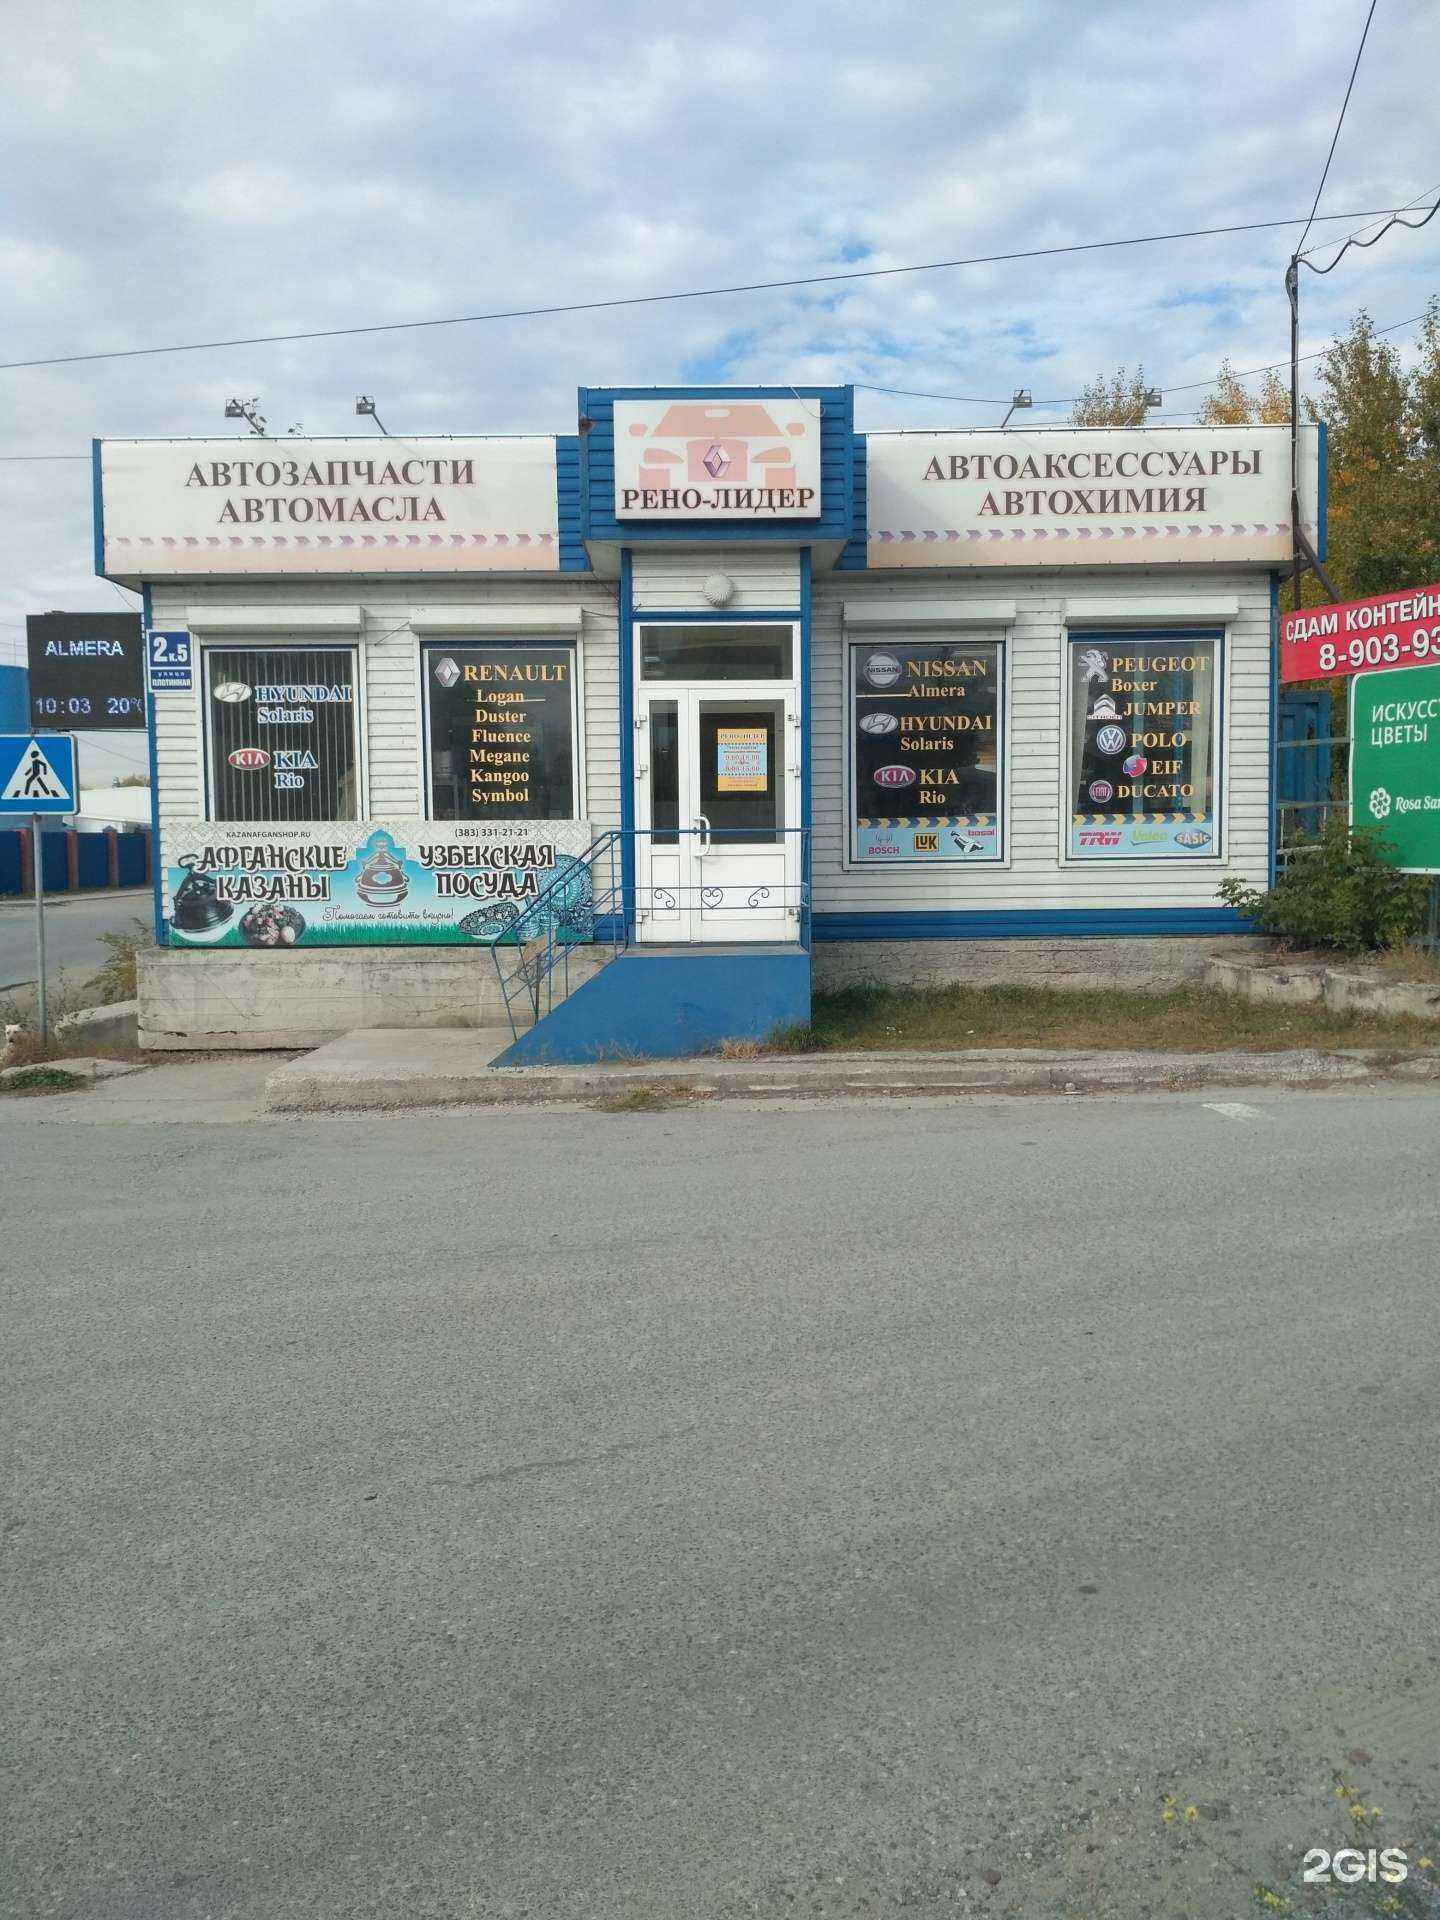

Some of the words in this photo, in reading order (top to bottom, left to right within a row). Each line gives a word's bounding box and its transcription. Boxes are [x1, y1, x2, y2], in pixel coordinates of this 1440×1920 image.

[185, 459, 475, 488] АВТОЗАПЧАСТИ
[922, 450, 1263, 481] АВТОАКСЕССУАРЫ
[621, 488, 815, 513] РЕНО-ЛИДЕР
[977, 487, 1208, 516] АВТОХИМИЯ
[216, 496, 446, 524] АВТОМАСЛА
[1286, 612, 1338, 643] СДАМ
[44, 640, 124, 656] ALMERA
[1319, 625, 1440, 671] 8-903-93
[906, 660, 988, 677] NISSAN
[1111, 656, 1210, 673] PEUGEOT
[464, 665, 566, 681] RENAULT
[908, 684, 966, 697] Almera
[1111, 678, 1158, 692] Boxer
[255, 685, 352, 702] HYUNDAI
[476, 689, 525, 706] Logan
[36, 698, 91, 714] 10:03
[1123, 701, 1201, 717] JUMPER
[1372, 699, 1440, 724] ИСКУСС
[258, 707, 314, 723] Solaris
[476, 709, 527, 723] Duster
[900, 715, 993, 731] HYUNDAI
[472, 729, 531, 743] Fluence
[1131, 732, 1187, 748] POLO
[1371, 723, 1428, 747] ЦВЕТЫ
[900, 736, 954, 751] Solaris
[273, 751, 319, 768] KIA
[470, 749, 530, 766] Megane
[274, 772, 304, 788] Rio
[470, 769, 530, 785] Kangoo
[881, 771, 910, 783] KIA
[919, 769, 960, 785] KIA
[472, 788, 530, 804] Symbol
[919, 790, 946, 804] Rio
[1117, 784, 1194, 798] DUCATO
[1395, 796, 1421, 813] Rosa
[454, 829, 479, 838] (383)
[481, 828, 529, 837] 331-21-21
[419, 845, 554, 869] УЗБЕКСКАЯ
[868, 846, 900, 854] BOSCH
[200, 845, 347, 872] АФГАНСКИЕ
[218, 875, 331, 901] КАЗАНЫ
[436, 873, 538, 898] ПОСУДА
